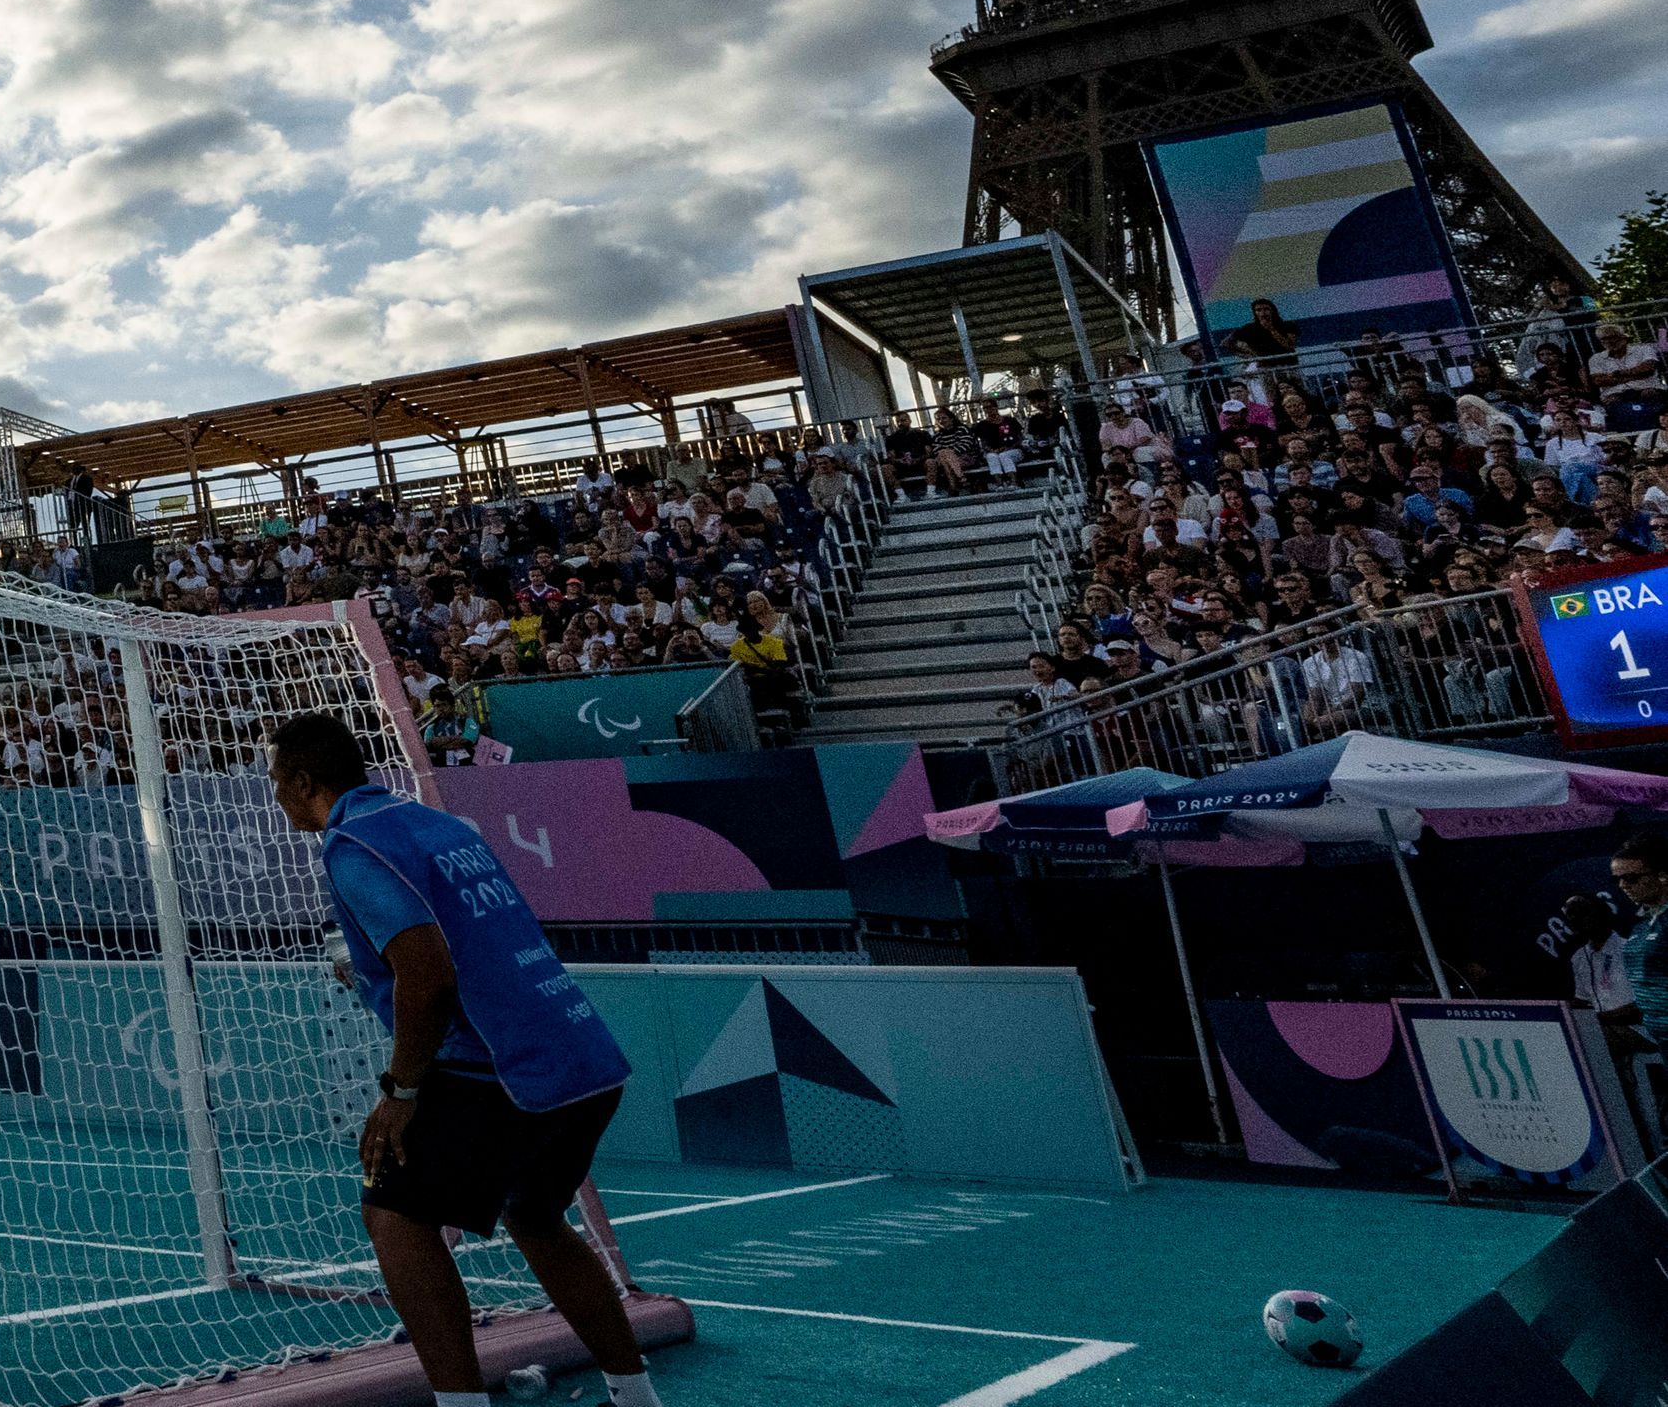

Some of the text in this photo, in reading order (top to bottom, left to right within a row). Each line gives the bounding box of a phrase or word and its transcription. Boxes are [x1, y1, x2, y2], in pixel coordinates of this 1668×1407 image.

[1592, 582, 1663, 615] BRA
[1609, 629, 1651, 680] 1
[1637, 699, 1653, 718] 0
[1241, 790, 1299, 805] 2024
